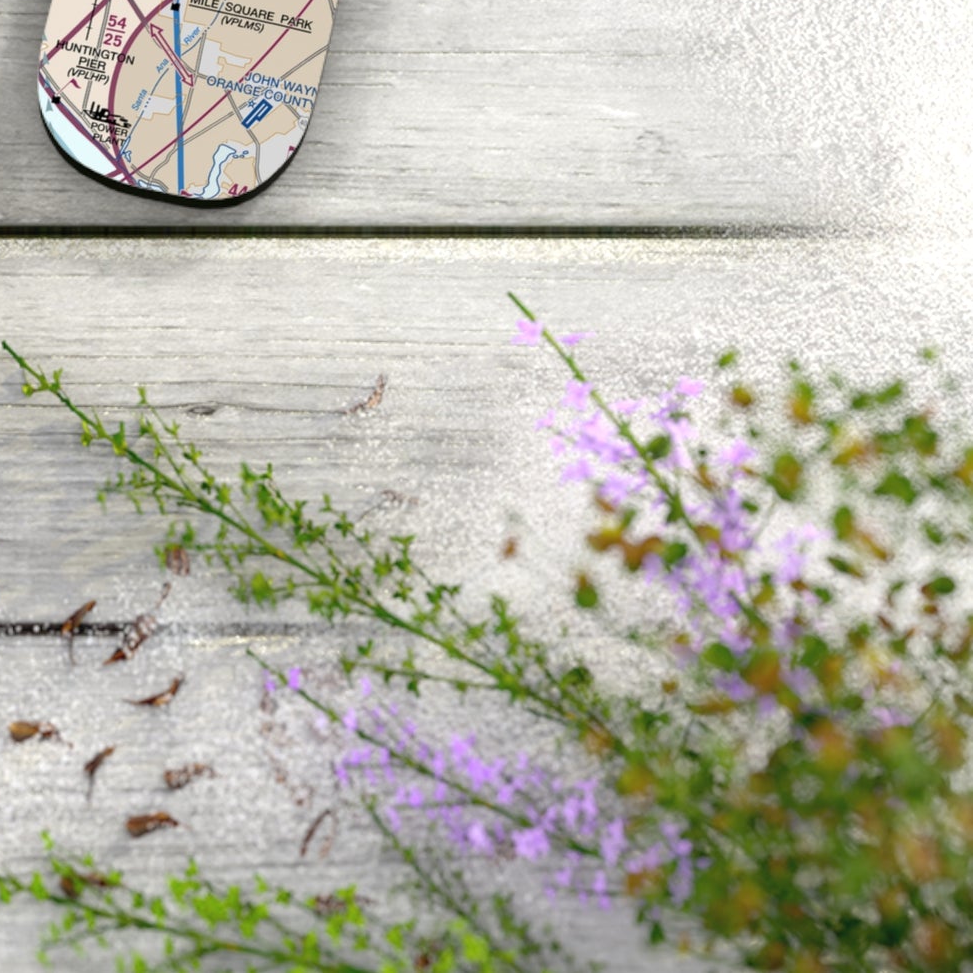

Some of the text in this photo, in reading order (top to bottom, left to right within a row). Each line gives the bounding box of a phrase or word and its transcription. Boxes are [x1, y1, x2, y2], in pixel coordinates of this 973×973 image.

[108, 15, 127, 29] 54
[225, 2, 275, 21] SQUARE
[281, 15, 313, 30] PARK
[221, 16, 264, 33] (VPLMS)
[104, 33, 122, 47] 25
[56, 40, 135, 65] HUNTINGTON
[78, 57, 106, 70] PIER
[132, 27, 200, 111] Santa Ana River
[67, 68, 109, 85] (VPLHP)
[245, 72, 279, 88] JOHN
[206, 76, 314, 108] ORANGE COUNTY
[91, 122, 128, 137] POWER
[93, 133, 127, 146] PLANT
